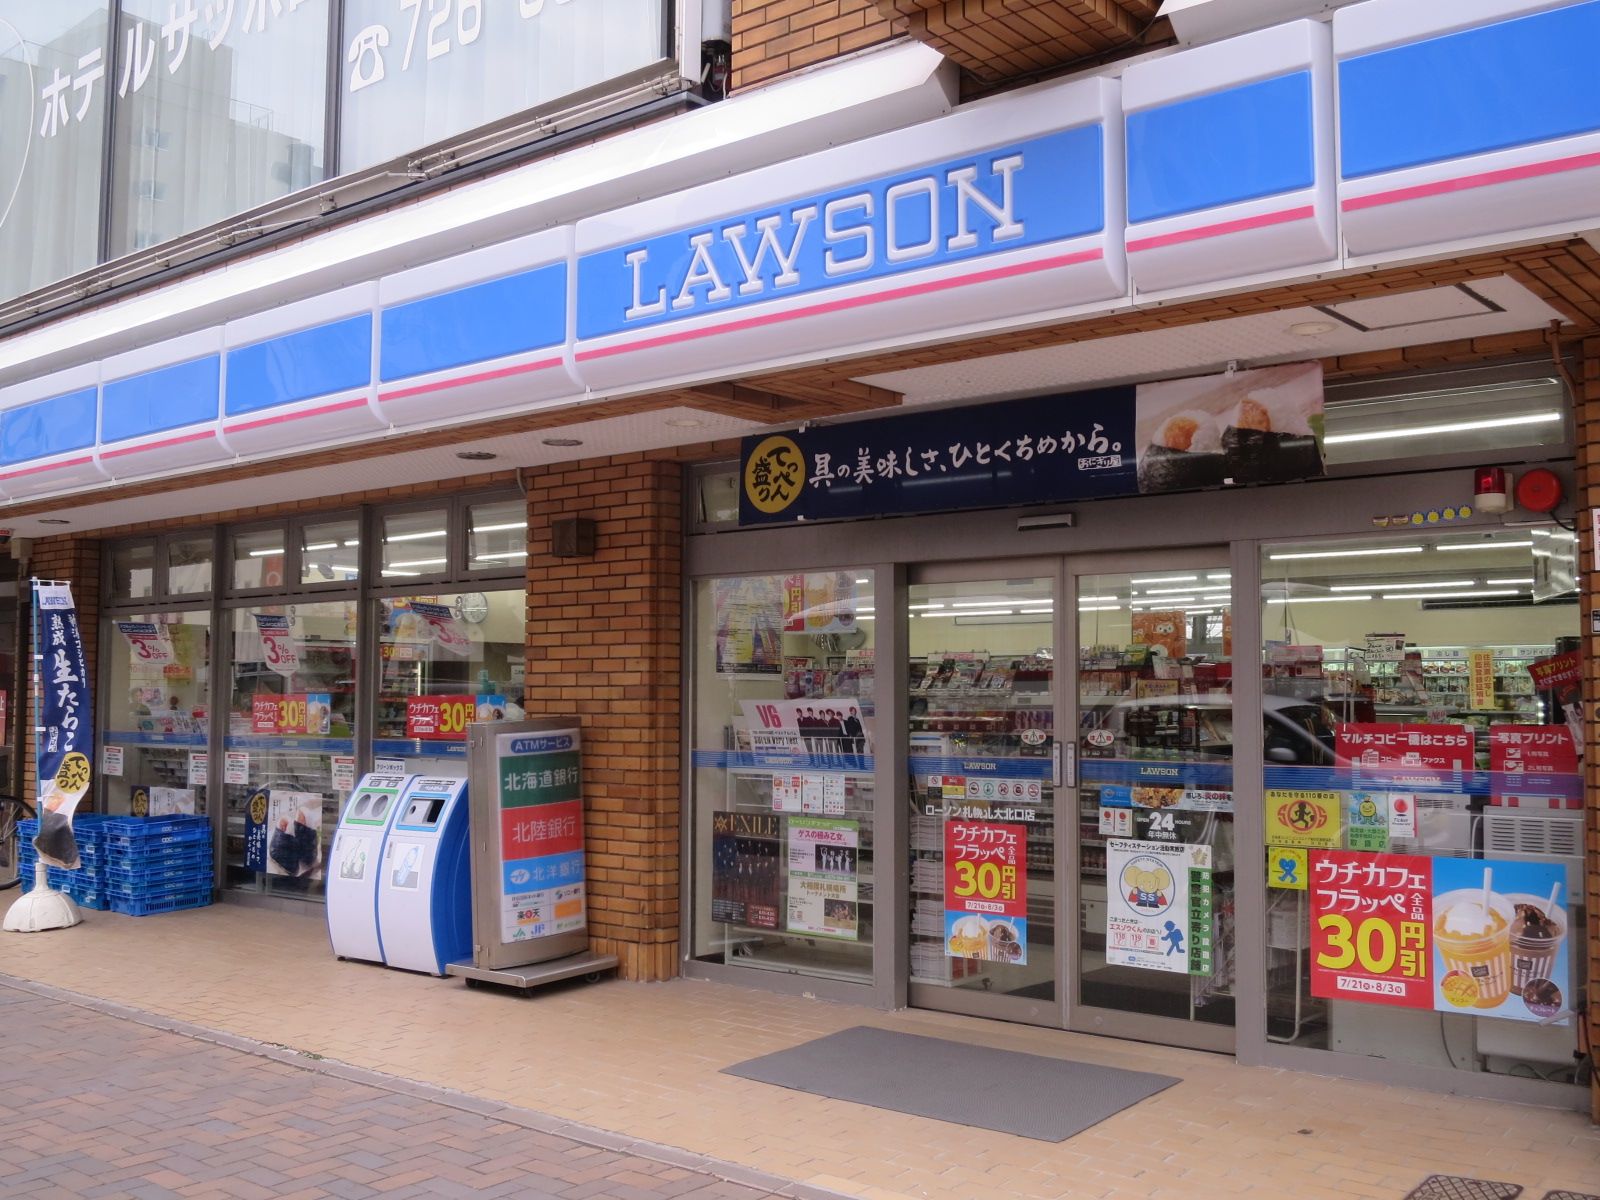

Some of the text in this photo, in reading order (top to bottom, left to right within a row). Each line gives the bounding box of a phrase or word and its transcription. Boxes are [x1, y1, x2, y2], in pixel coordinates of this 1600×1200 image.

[625, 154, 1025, 321] LAWSON
[752, 456, 772, 503] 盛り
[767, 446, 799, 502] てっぺん
[280, 654, 296, 664] OFF
[53, 648, 79, 752] 生たらこ
[409, 703, 439, 714] ウチカフェ
[278, 701, 299, 727] 30
[440, 703, 465, 732] 30
[755, 704, 782, 728] V6
[514, 737, 571, 752] ATMサービス
[1341, 733, 1468, 747] マルチコピー機はこちら
[1498, 732, 1568, 744] 写真プリント
[963, 762, 998, 771] LAWSON
[1380, 755, 1398, 763] コピー
[504, 766, 579, 792] 北海道銀行
[1140, 767, 1179, 776] LAWSON
[512, 815, 576, 843] 北陸銀行
[730, 813, 778, 835] EXILE
[1149, 811, 1175, 831] 24
[953, 824, 1017, 845] ウチカフェ
[1147, 831, 1177, 840] 年中無休
[954, 844, 1017, 865] フラッペ 全品
[533, 859, 581, 881] 北洋銀行
[953, 860, 1016, 900] 30 円引
[1315, 859, 1426, 890] ウチカフェ
[1316, 888, 1424, 921] フラッペ 全品
[1316, 913, 1425, 978] 30 円引
